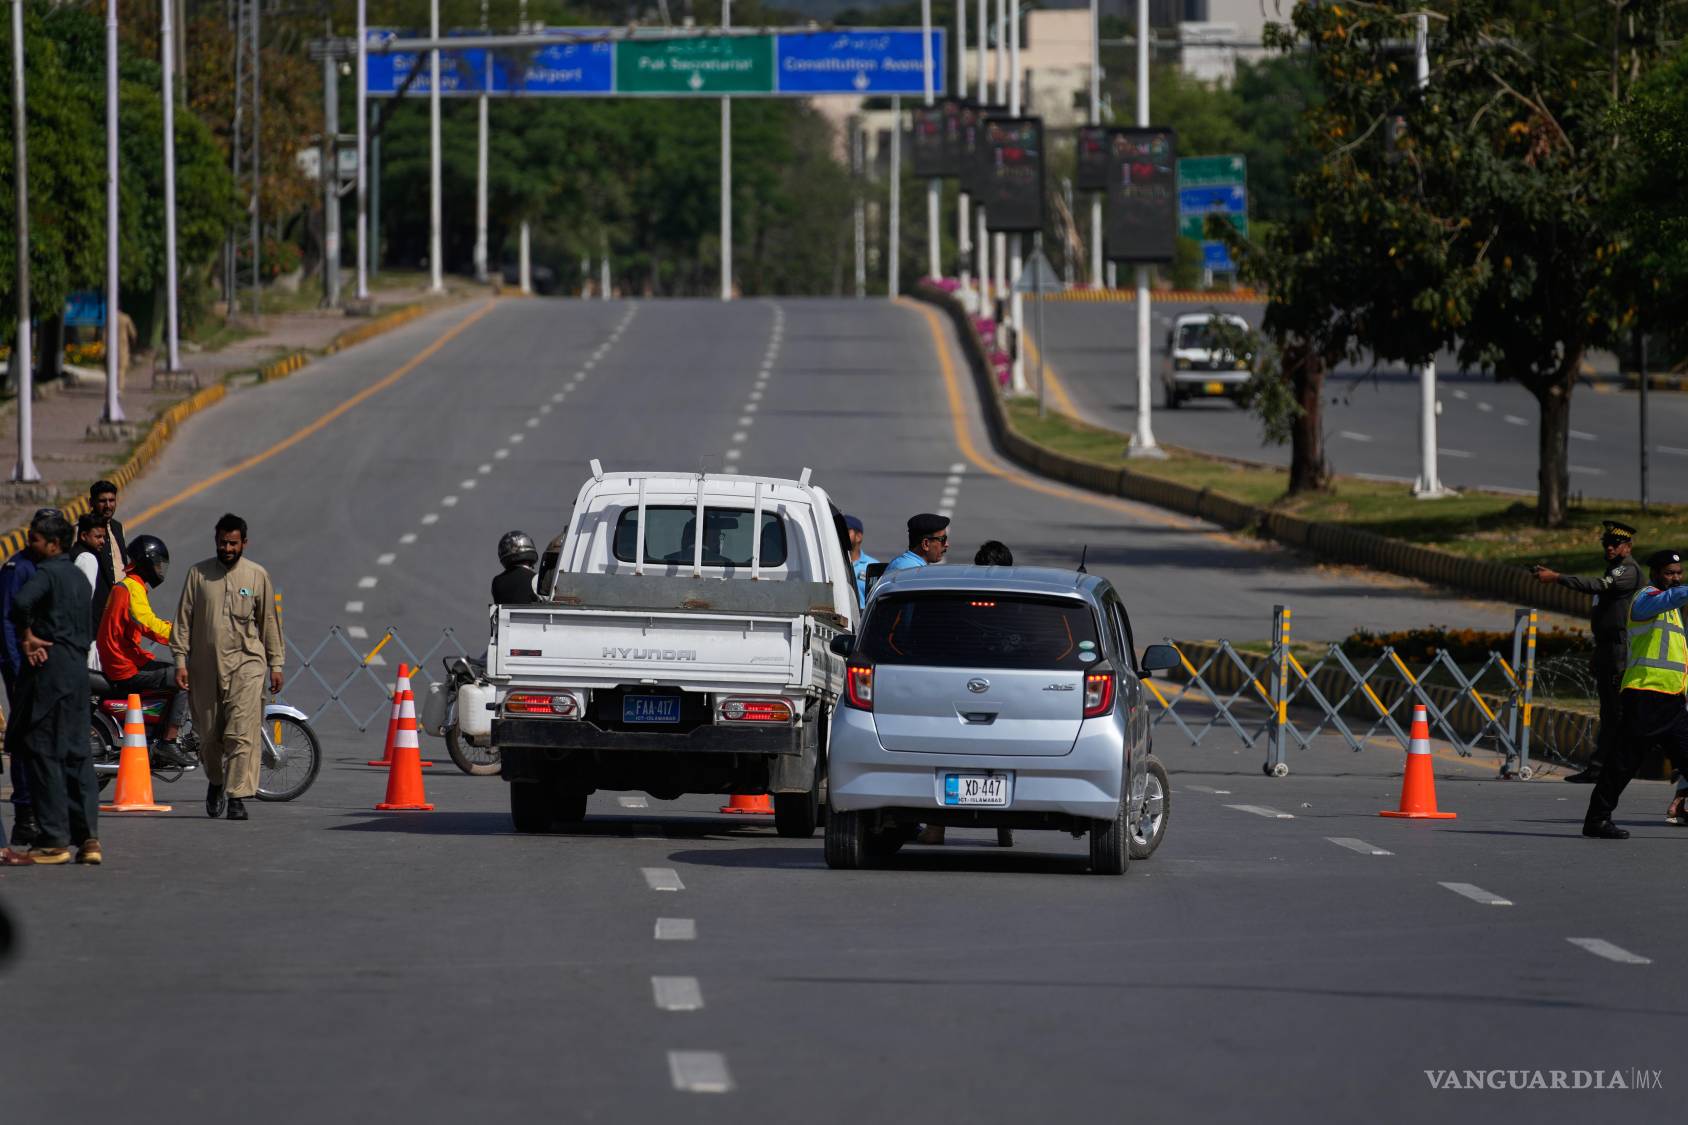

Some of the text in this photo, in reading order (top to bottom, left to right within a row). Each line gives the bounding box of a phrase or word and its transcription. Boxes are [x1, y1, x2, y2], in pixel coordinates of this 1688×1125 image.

[784, 56, 878, 71] Constitution
[525, 66, 583, 84] Airport
[602, 647, 697, 661] HYUNDAI
[636, 700, 673, 716] FAA-417
[965, 779, 1001, 797] XD-447
